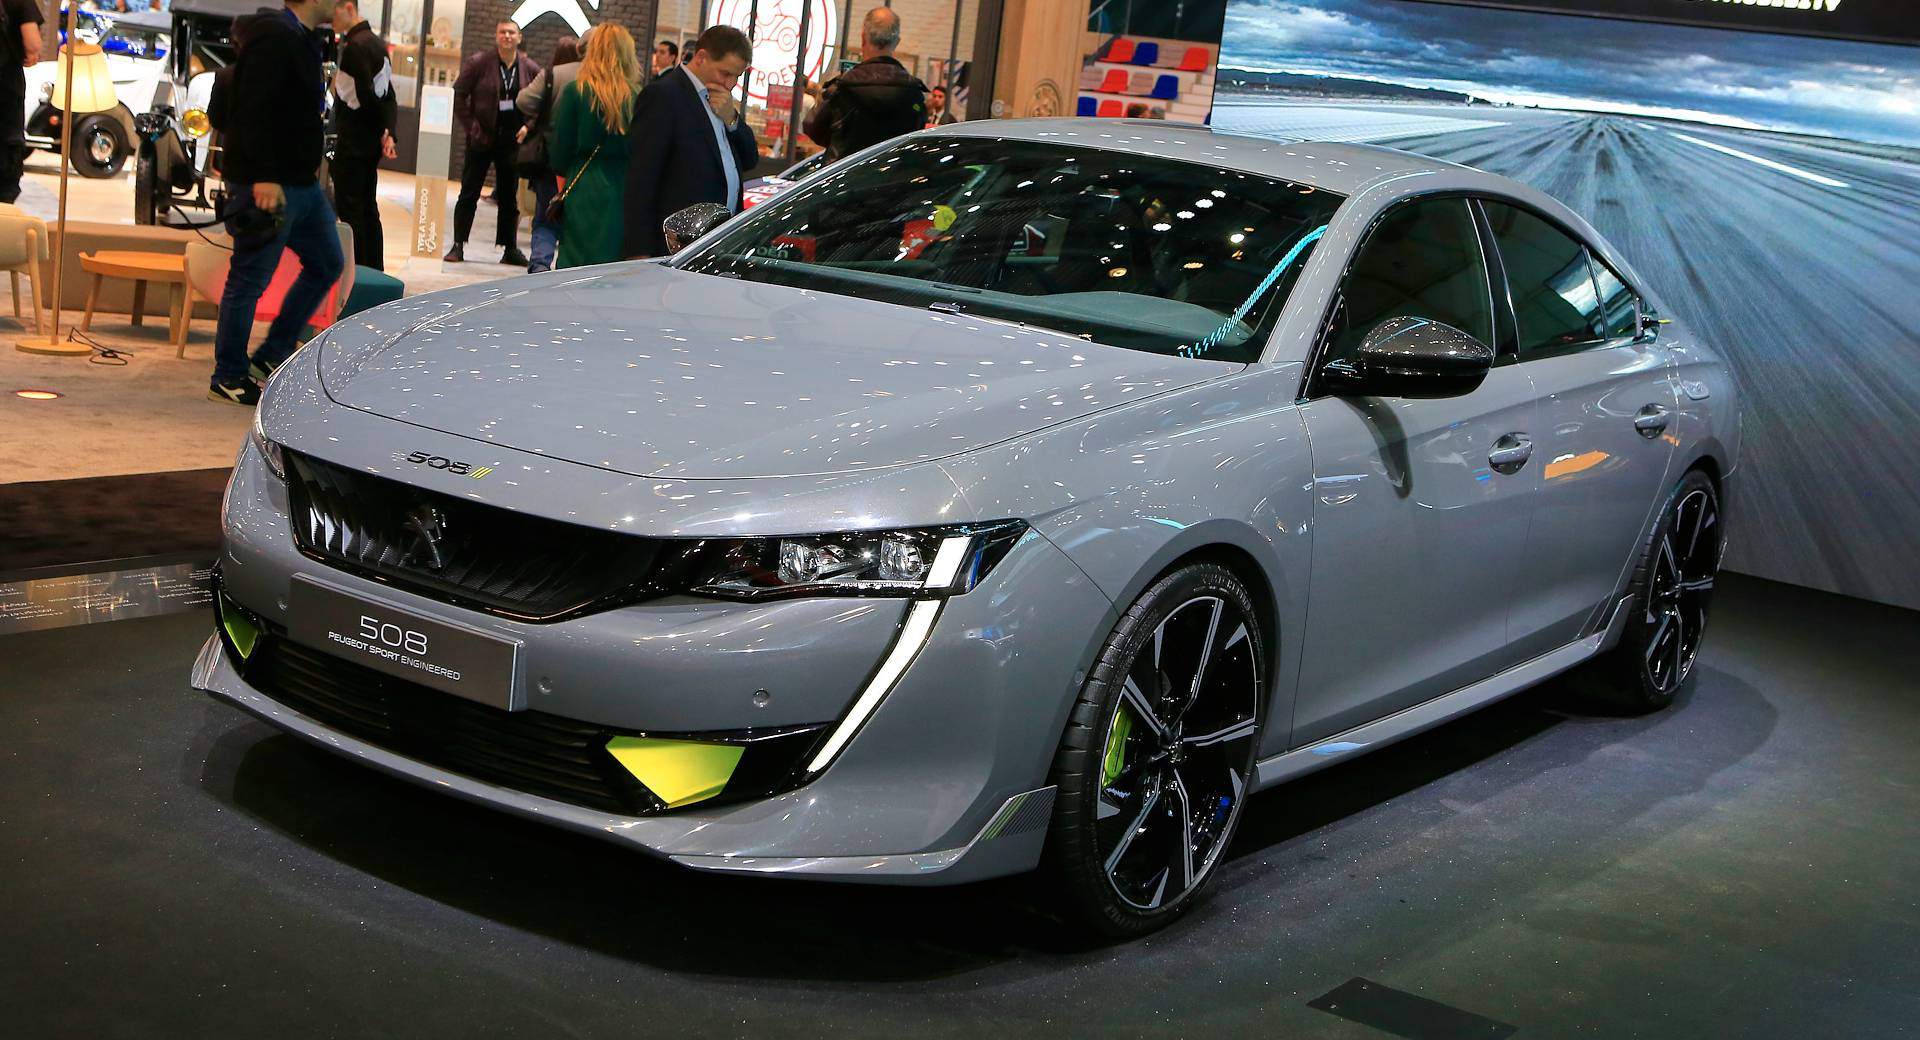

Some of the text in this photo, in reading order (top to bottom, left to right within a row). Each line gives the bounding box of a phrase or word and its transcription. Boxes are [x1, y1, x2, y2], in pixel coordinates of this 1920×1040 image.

[406, 451, 472, 475] 508
[360, 615, 428, 655] 508
[328, 631, 461, 681] PEUGEOT SPORT ENGINEERED
